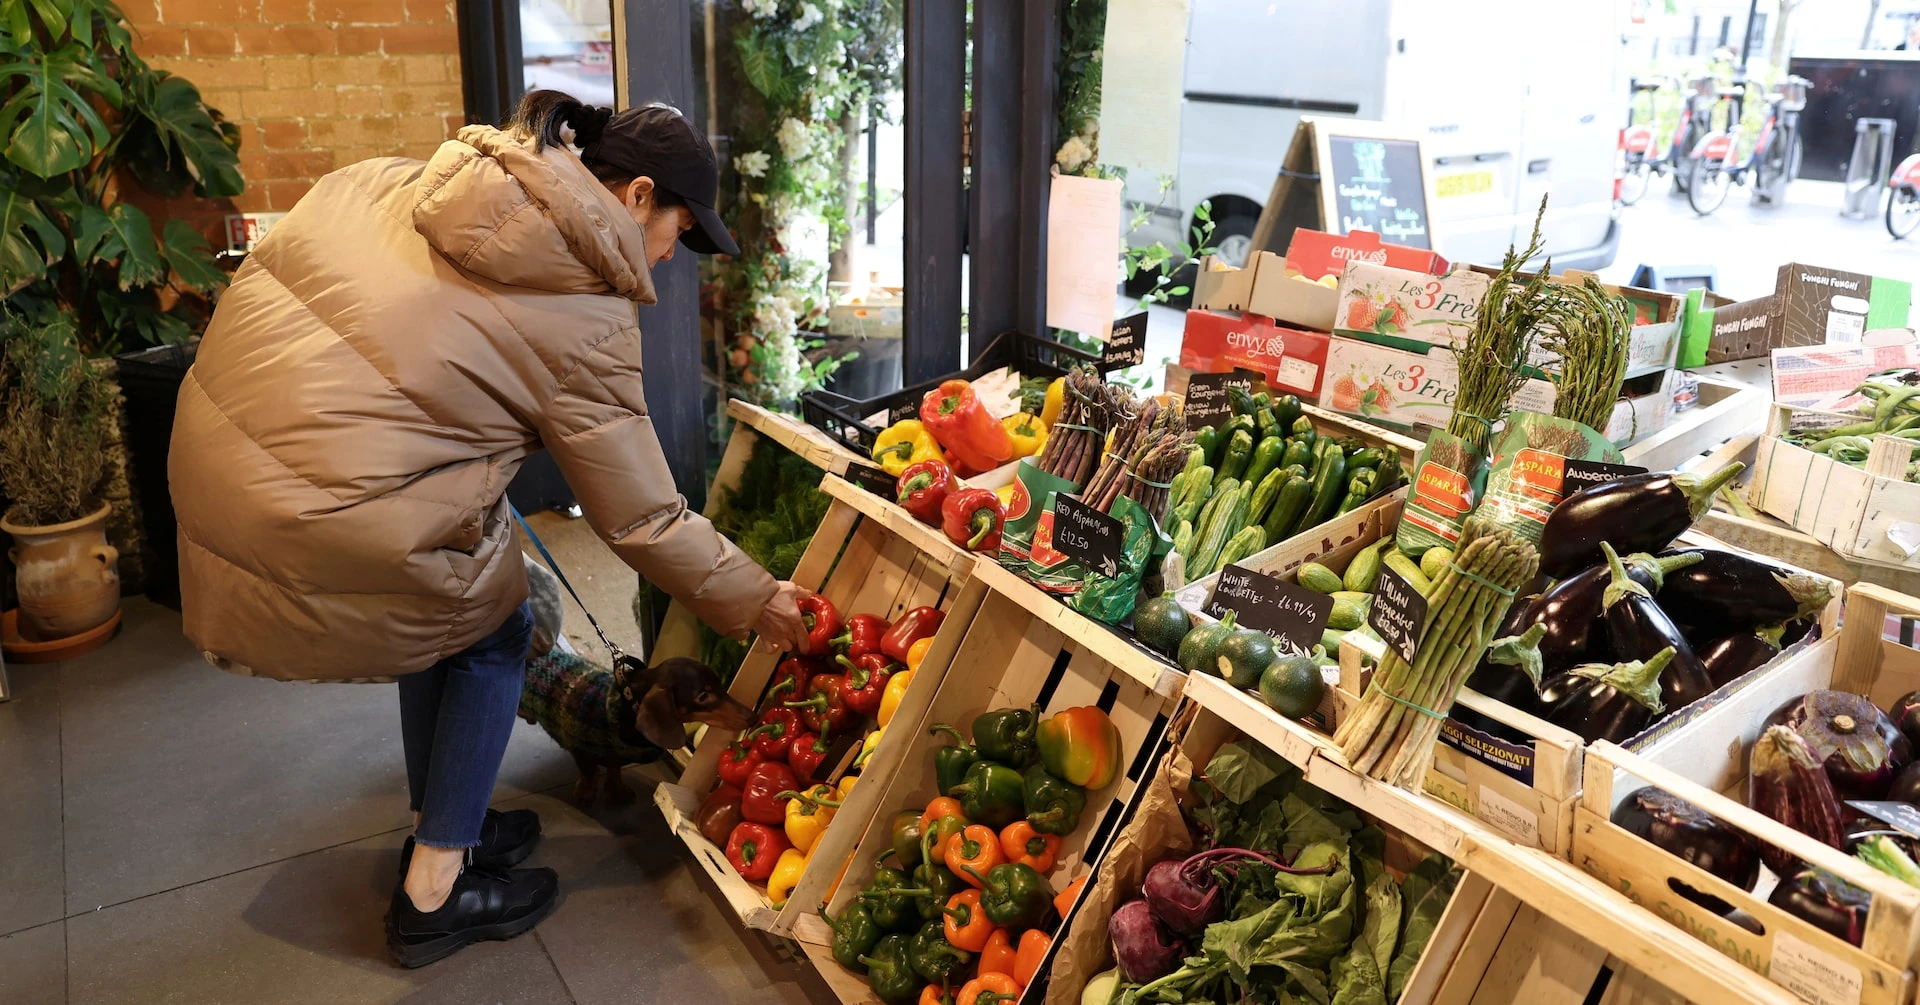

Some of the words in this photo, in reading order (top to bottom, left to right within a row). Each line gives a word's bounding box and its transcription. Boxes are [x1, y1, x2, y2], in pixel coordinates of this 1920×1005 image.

[1399, 280, 1424, 296] Les
[1415, 281, 1442, 310] 3
[1226, 331, 1267, 358] envy
[1383, 364, 1407, 380] Les
[1398, 364, 1425, 393] 3
[1056, 501, 1071, 516] RED
[1380, 573, 1409, 608] ITALIAN
[1442, 724, 1464, 741] AGGI
[1464, 734, 1532, 766] SELEZIONATI
